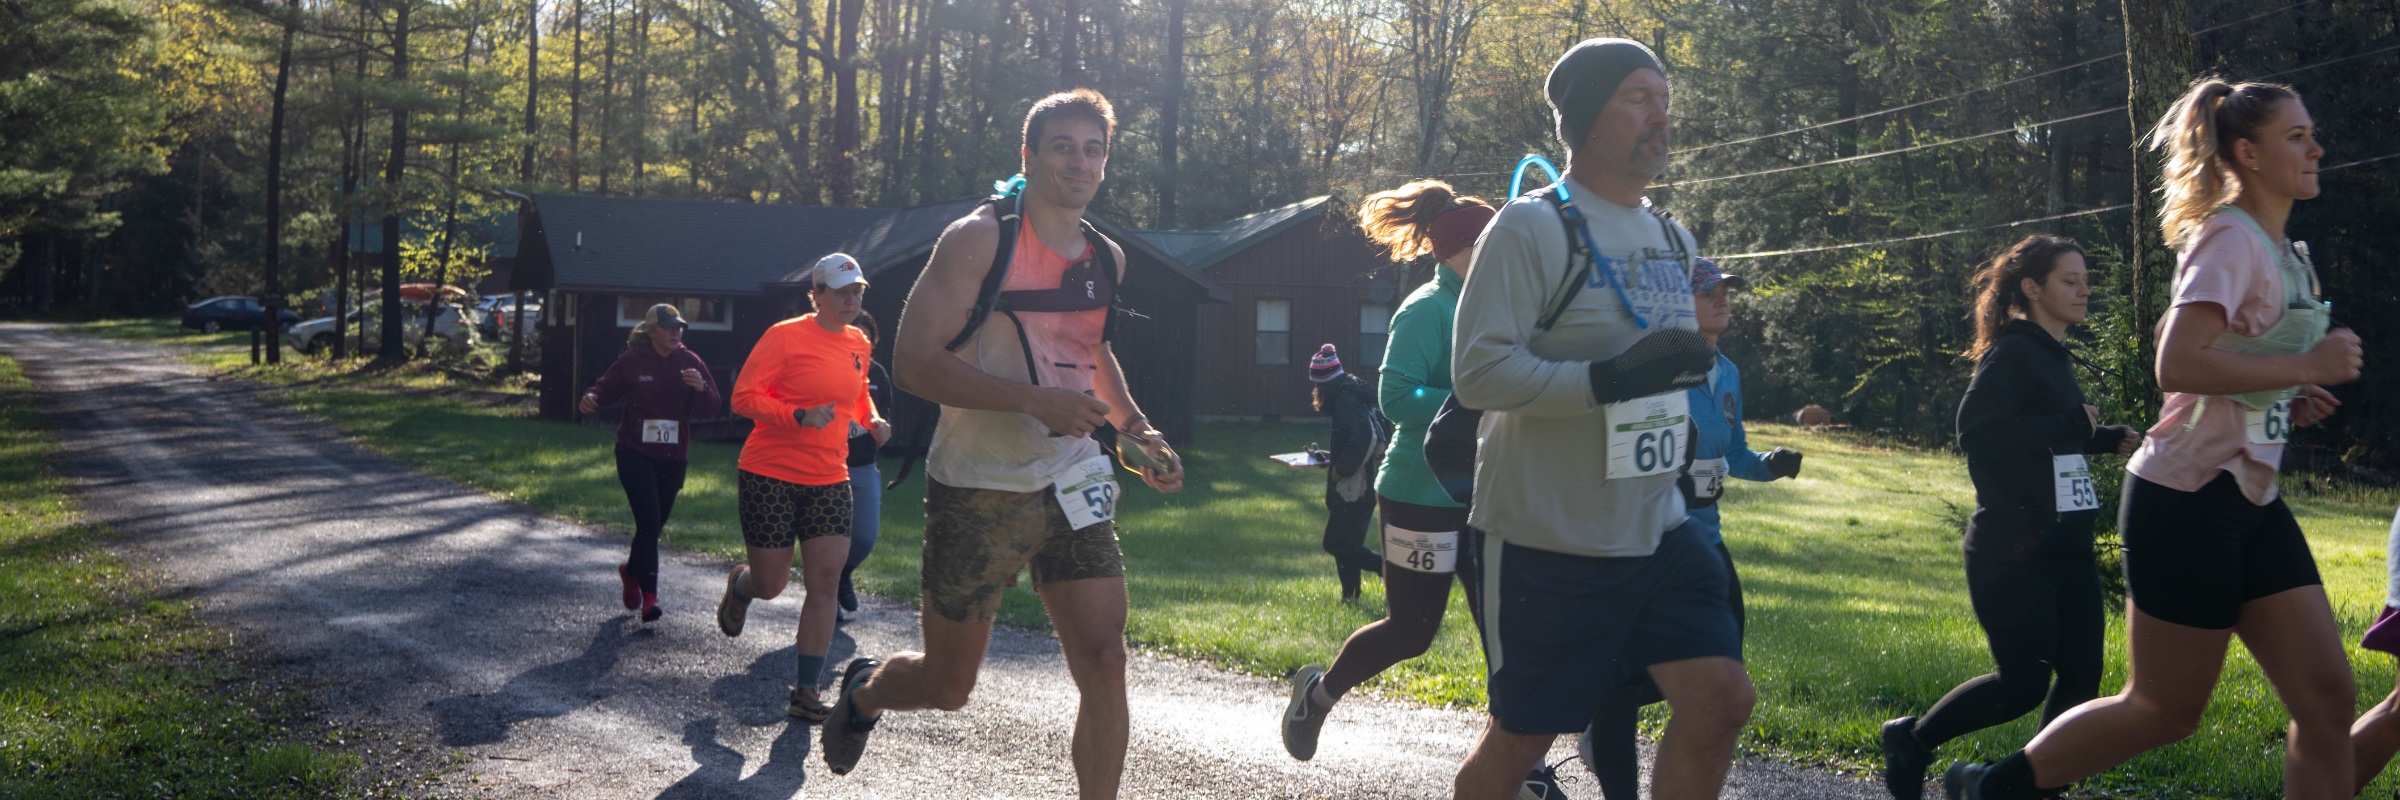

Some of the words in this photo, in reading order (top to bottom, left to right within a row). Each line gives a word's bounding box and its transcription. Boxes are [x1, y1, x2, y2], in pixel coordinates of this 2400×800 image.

[1629, 290, 1689, 305] SOCCER
[656, 430, 670, 442] 10
[1635, 428, 1675, 473] 60
[1082, 483, 1114, 519] 58
[2072, 478, 2094, 508] 55
[1406, 550, 1436, 571] 46
